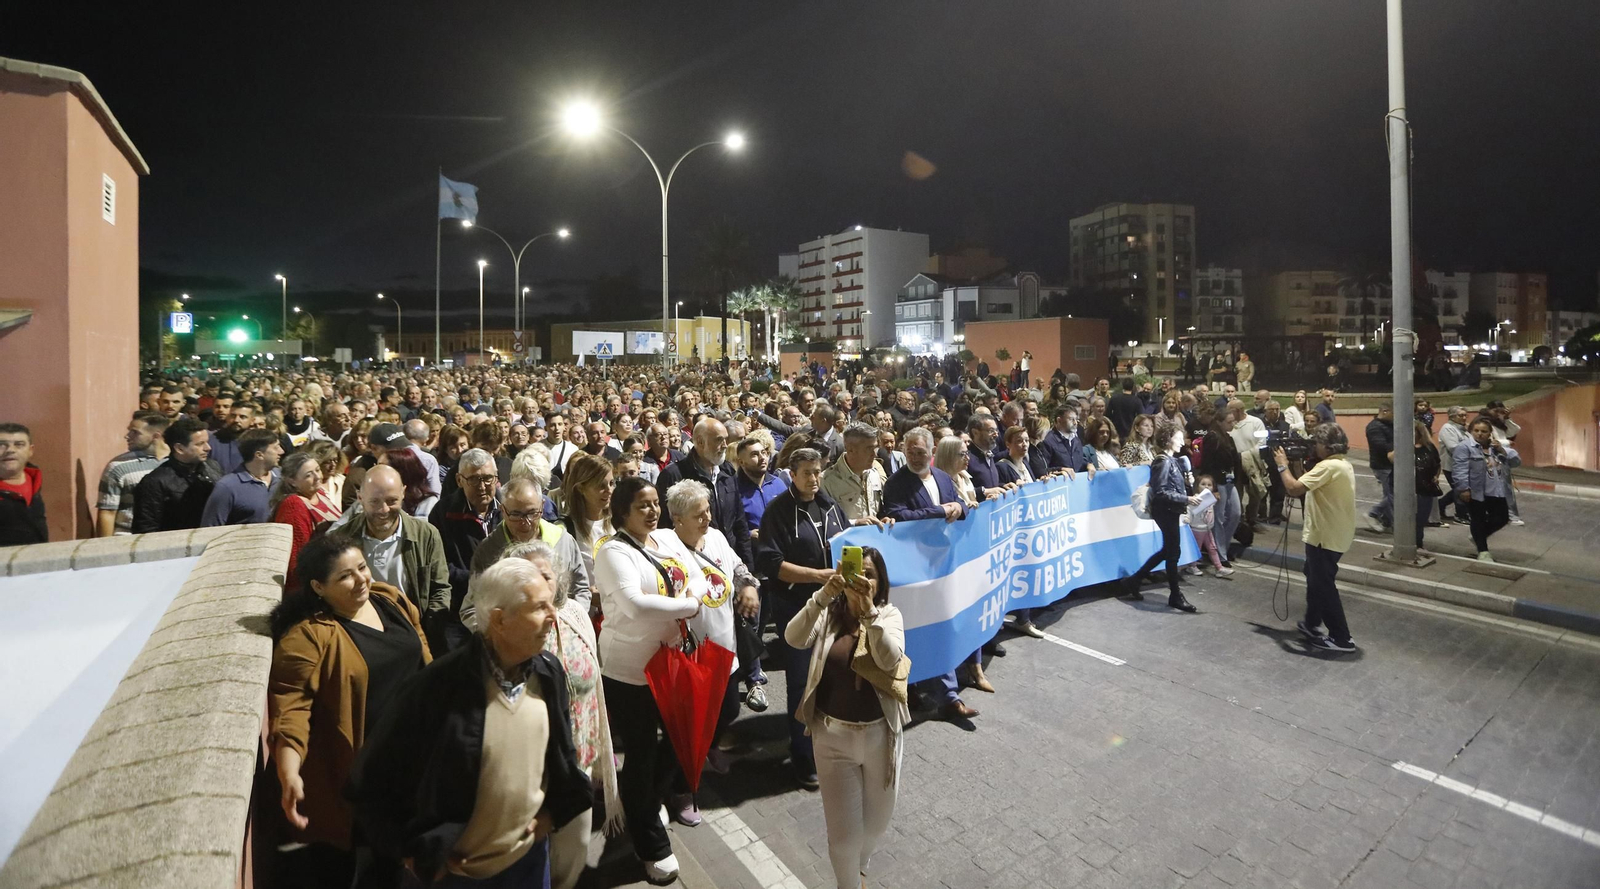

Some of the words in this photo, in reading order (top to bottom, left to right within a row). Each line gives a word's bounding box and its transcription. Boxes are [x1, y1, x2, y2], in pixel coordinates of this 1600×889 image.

[175, 314, 188, 327] P
[991, 518, 1005, 540] LA
[1037, 494, 1067, 518] CUENTA
[986, 543, 1011, 584] NO
[1013, 518, 1077, 560] SOMOS
[978, 551, 1085, 632] INVISIBLES
